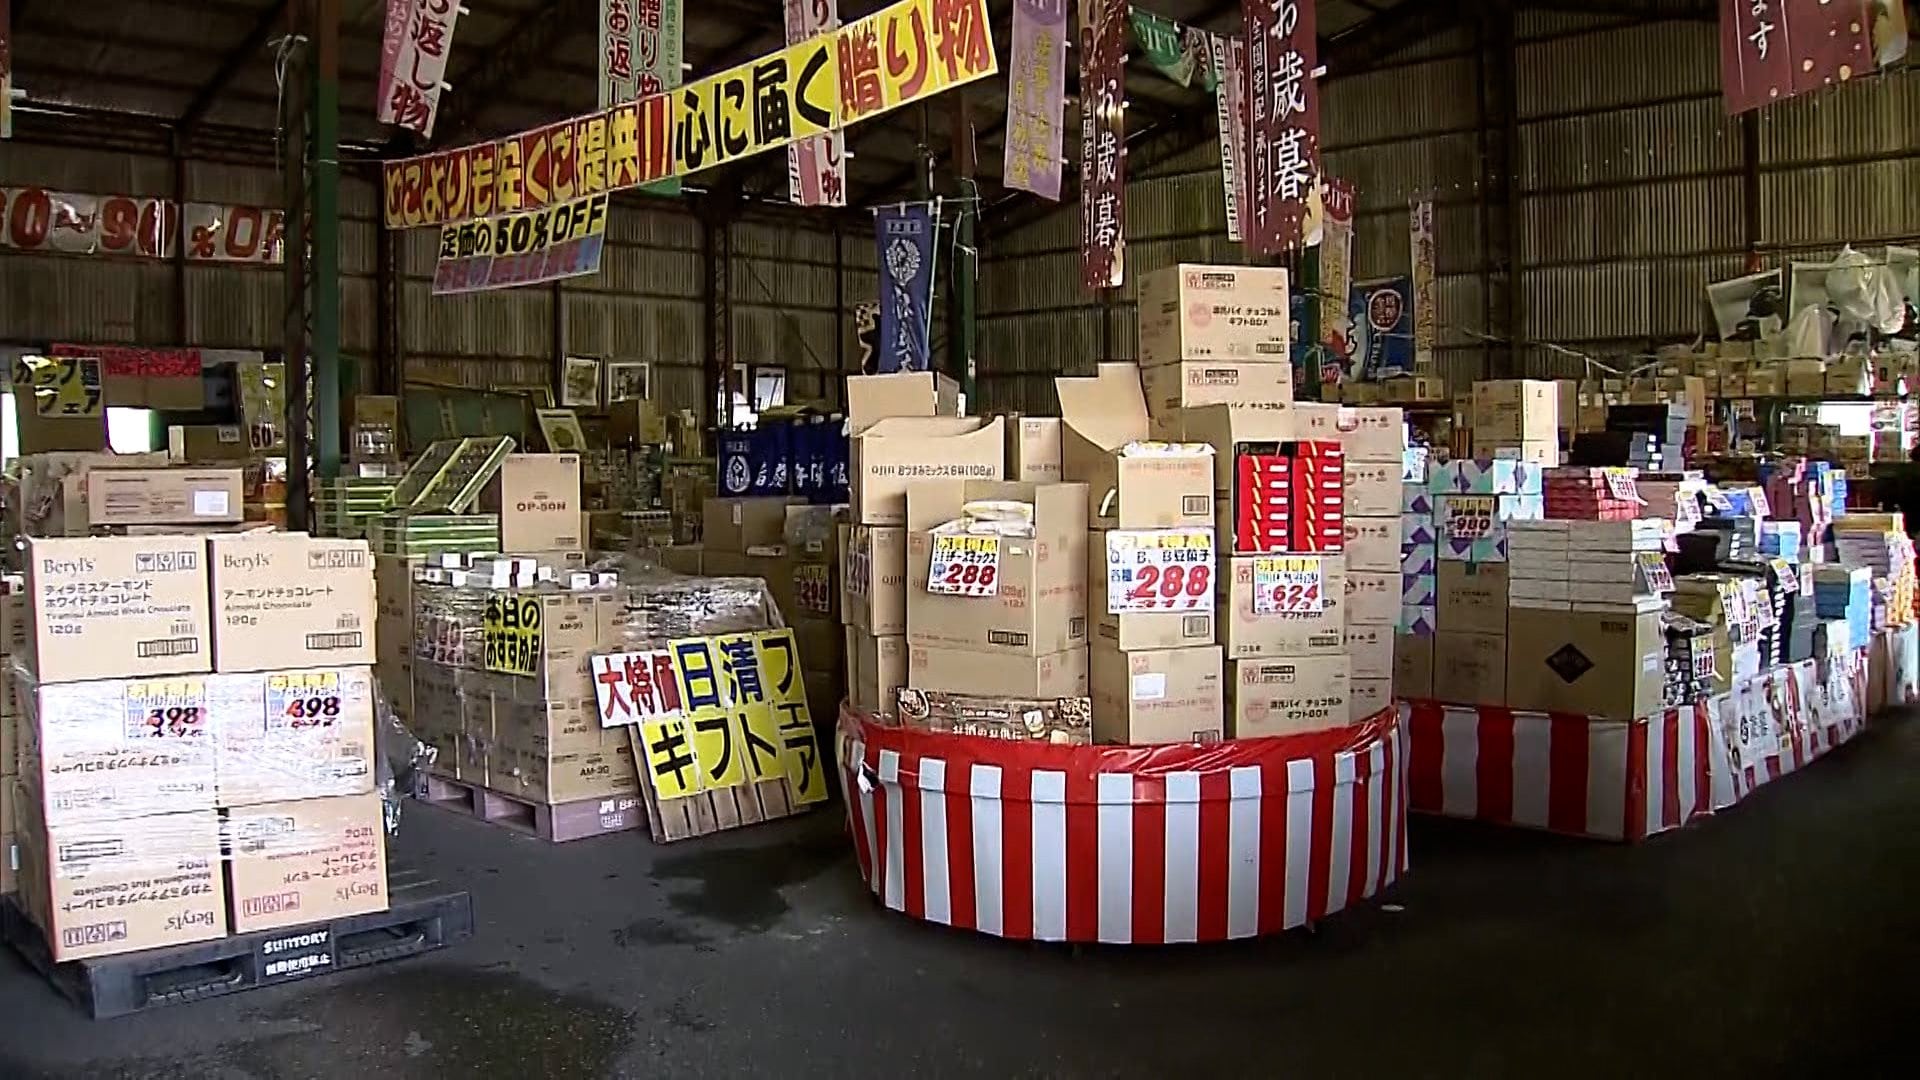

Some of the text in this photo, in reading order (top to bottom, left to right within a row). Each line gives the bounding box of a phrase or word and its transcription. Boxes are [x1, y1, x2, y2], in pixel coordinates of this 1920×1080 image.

[675, 0, 990, 170] 心に届く贈り物
[1270, 0, 1311, 202] お歳暮
[1095, 75, 1129, 248] お歳暮
[44, 556, 96, 577] Beryl's
[223, 553, 272, 573] Beryl's
[945, 563, 996, 586] 288
[1272, 584, 1319, 604] 624
[486, 595, 541, 630] 本日の
[598, 650, 683, 720] 大特価
[676, 637, 763, 712] 日清
[761, 635, 815, 796] フェア
[651, 712, 777, 791] ギフト
[335, 882, 379, 901] Beryl's
[166, 909, 215, 931] Beryl's
[263, 931, 329, 954] SUNTORY
